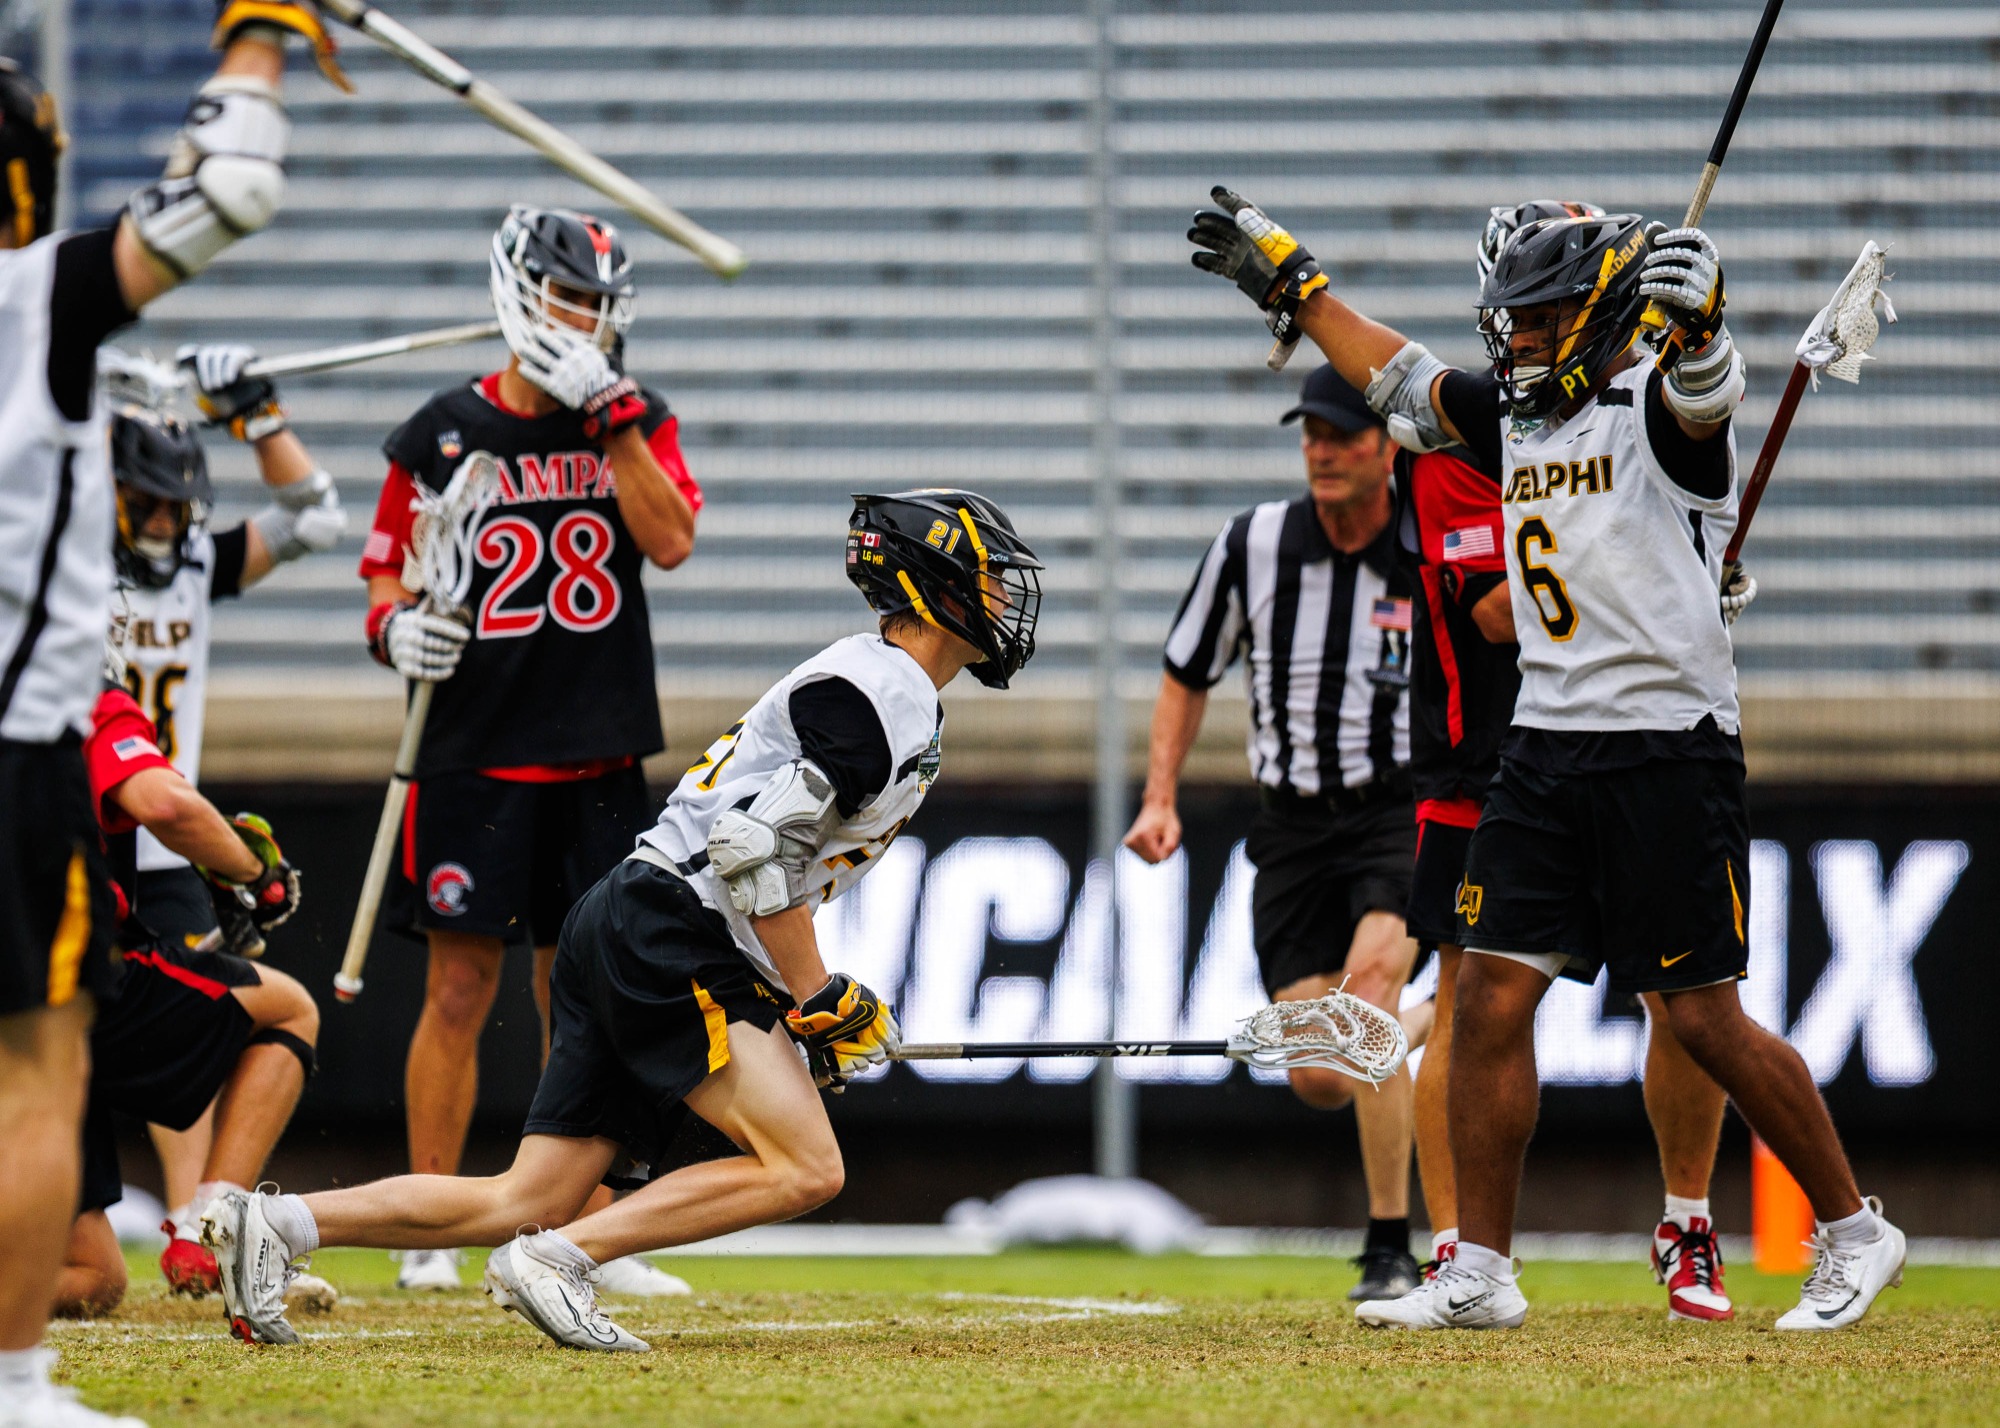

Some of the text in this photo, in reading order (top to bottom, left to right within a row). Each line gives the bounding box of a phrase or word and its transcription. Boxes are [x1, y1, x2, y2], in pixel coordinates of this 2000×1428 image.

[1606, 227, 1645, 280] ADELPH
[1560, 365, 1590, 399] PT
[487, 452, 620, 507] AMPA
[925, 519, 962, 554] 21
[474, 509, 622, 640] 28
[1515, 515, 1580, 642] 6
